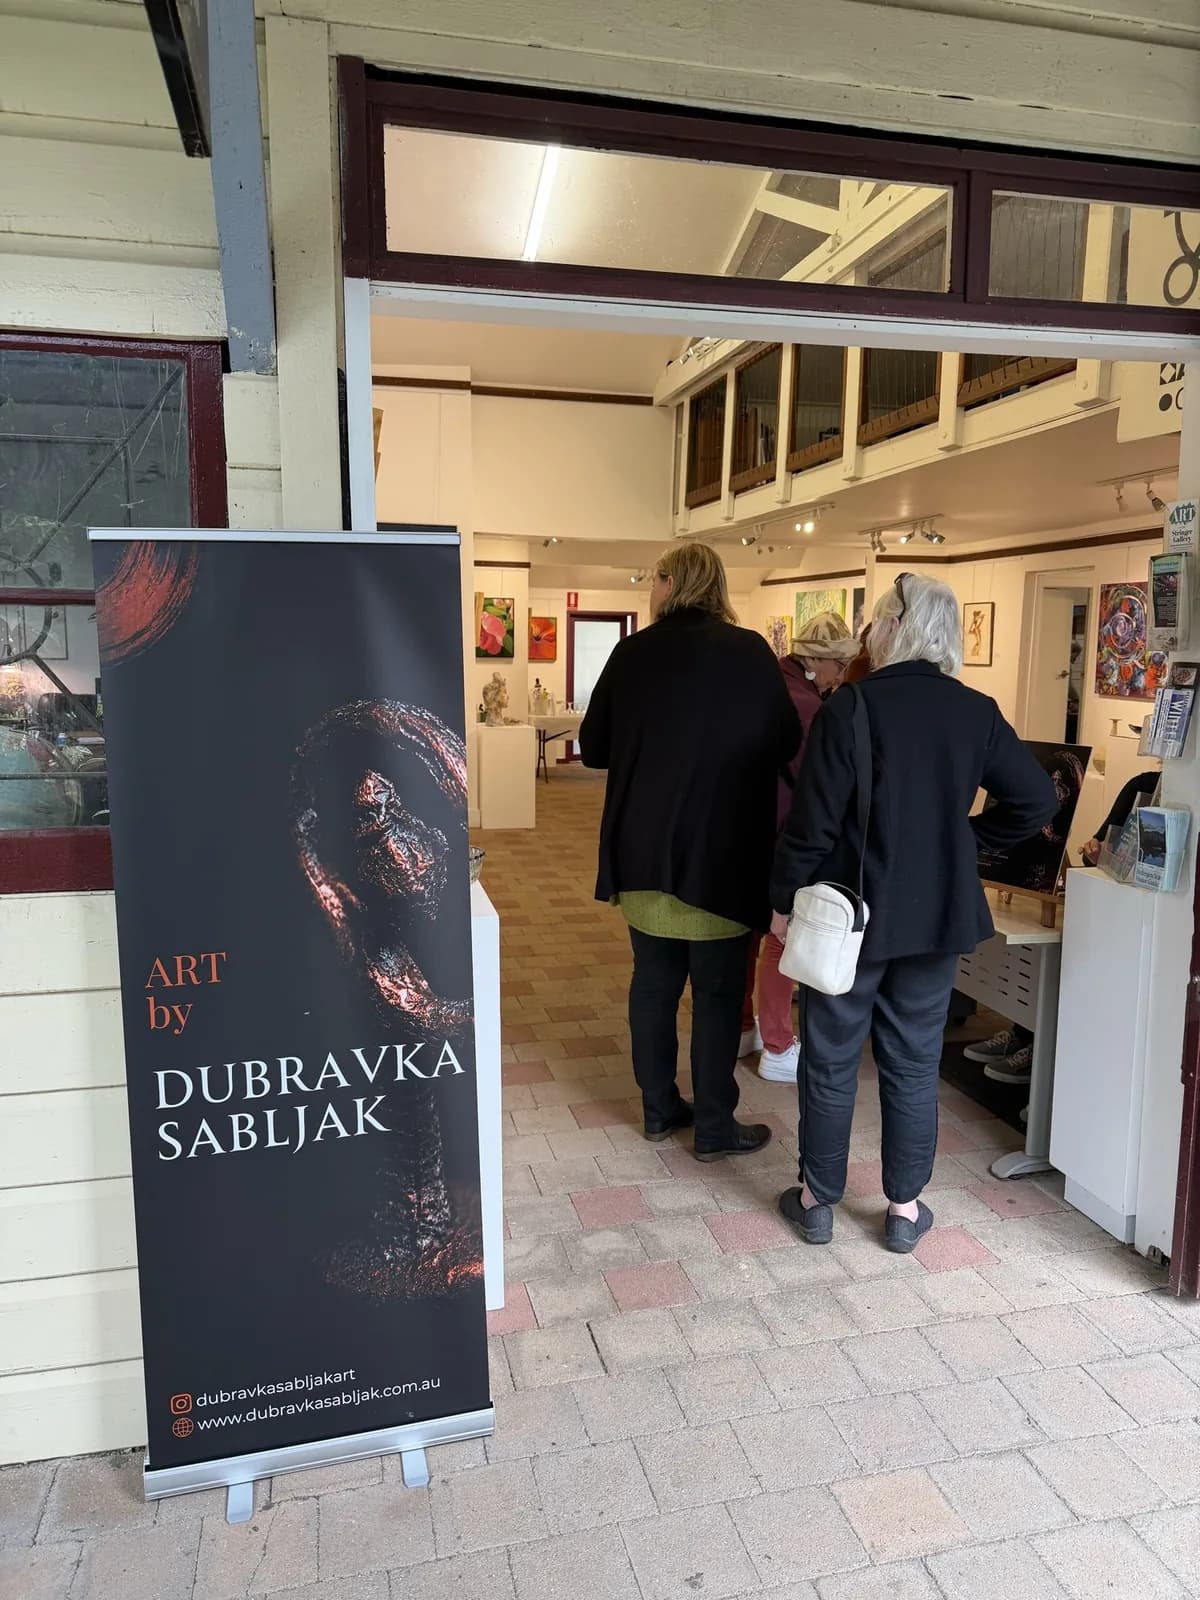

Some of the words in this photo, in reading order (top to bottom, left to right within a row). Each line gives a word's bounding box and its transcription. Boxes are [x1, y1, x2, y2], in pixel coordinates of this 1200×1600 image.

[1170, 507, 1194, 522] ART
[145, 951, 227, 989] ART
[146, 996, 193, 1035] by
[153, 1039, 466, 1110] DUBRAVKA
[158, 1095, 392, 1161] SABLJAK
[196, 1368, 356, 1407] dubravkasabljakart
[197, 1376, 441, 1431] www.dubravkasabljak.com.au
